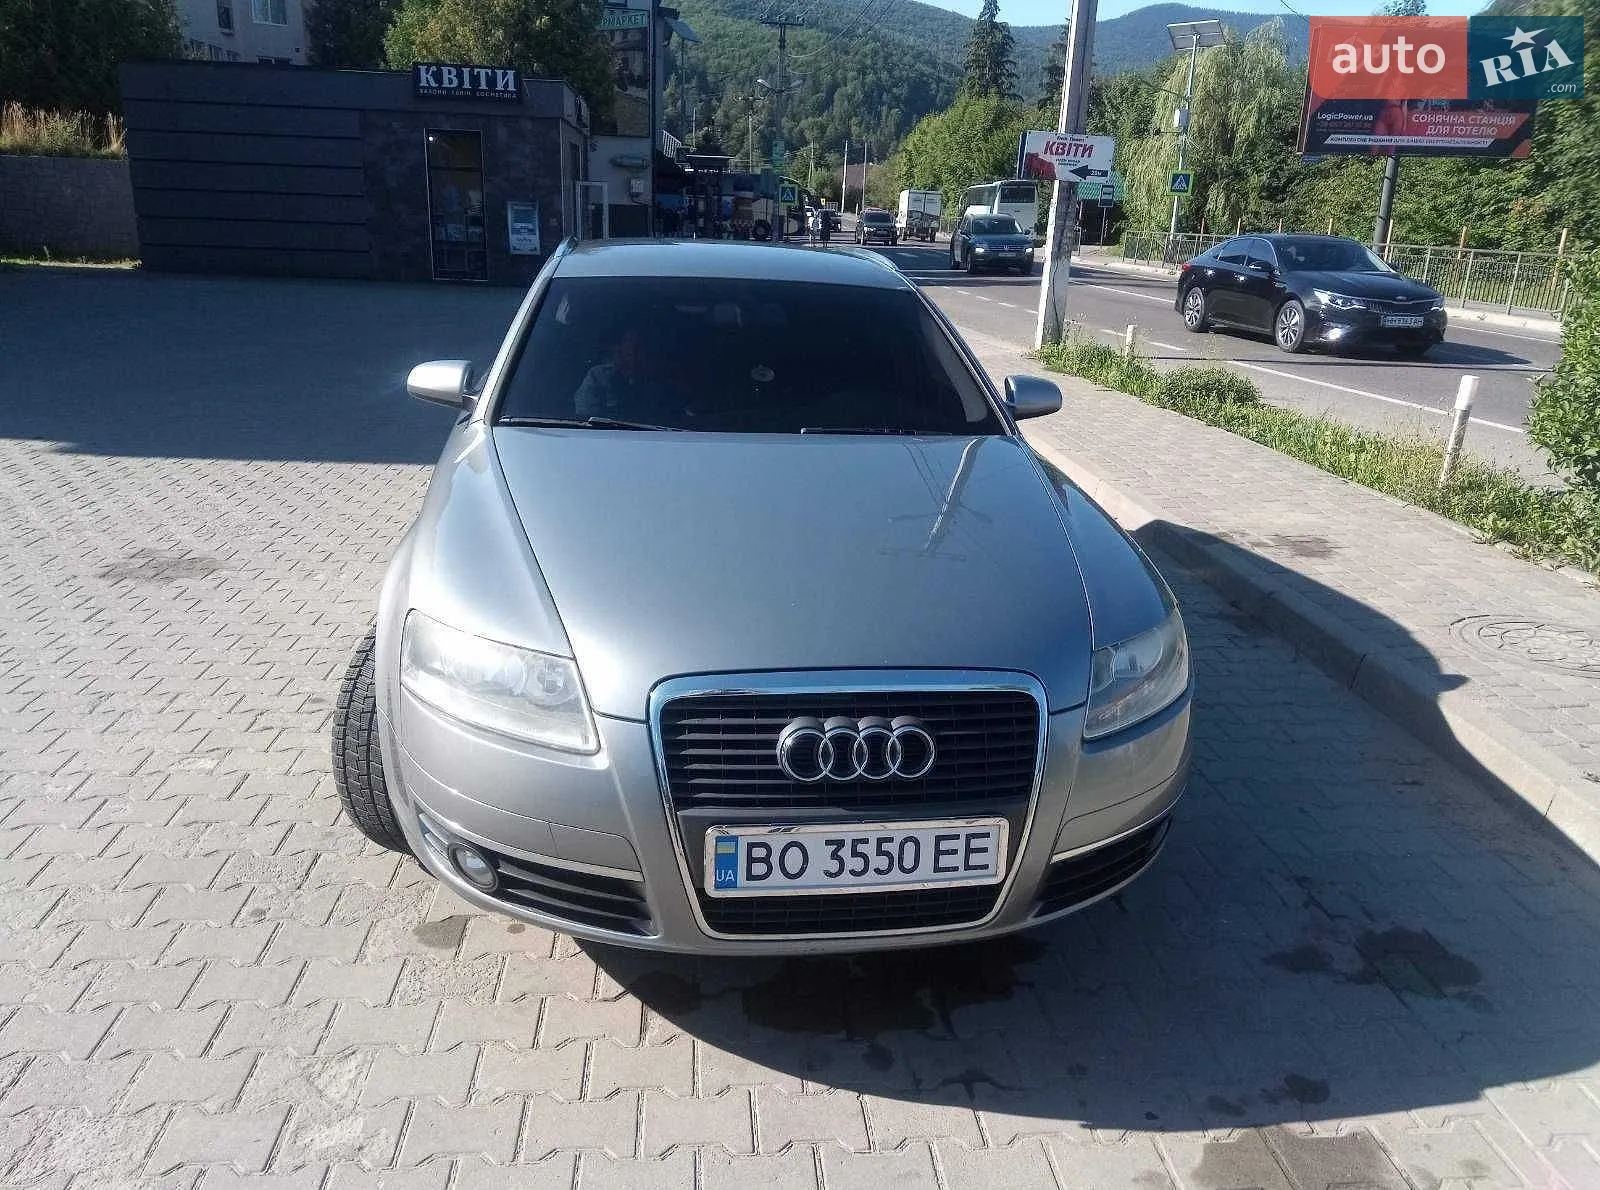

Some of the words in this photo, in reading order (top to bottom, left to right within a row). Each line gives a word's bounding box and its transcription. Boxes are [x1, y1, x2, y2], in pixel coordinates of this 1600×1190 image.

[418, 65, 517, 91] КВІТИ
[1317, 112, 1374, 121] LogicPower.ua
[1412, 113, 1465, 123] СОНЯЧНА
[1468, 115, 1516, 126] СТАНЦІЯ
[1425, 125, 1450, 136] ДЛЯ
[1452, 126, 1498, 136] ГОТЕЛЮ
[1043, 141, 1095, 158] КВІТИ
[745, 840, 809, 882] BO
[823, 835, 921, 879] 3550
[932, 832, 991, 874] EE
[715, 868, 735, 882] UA
